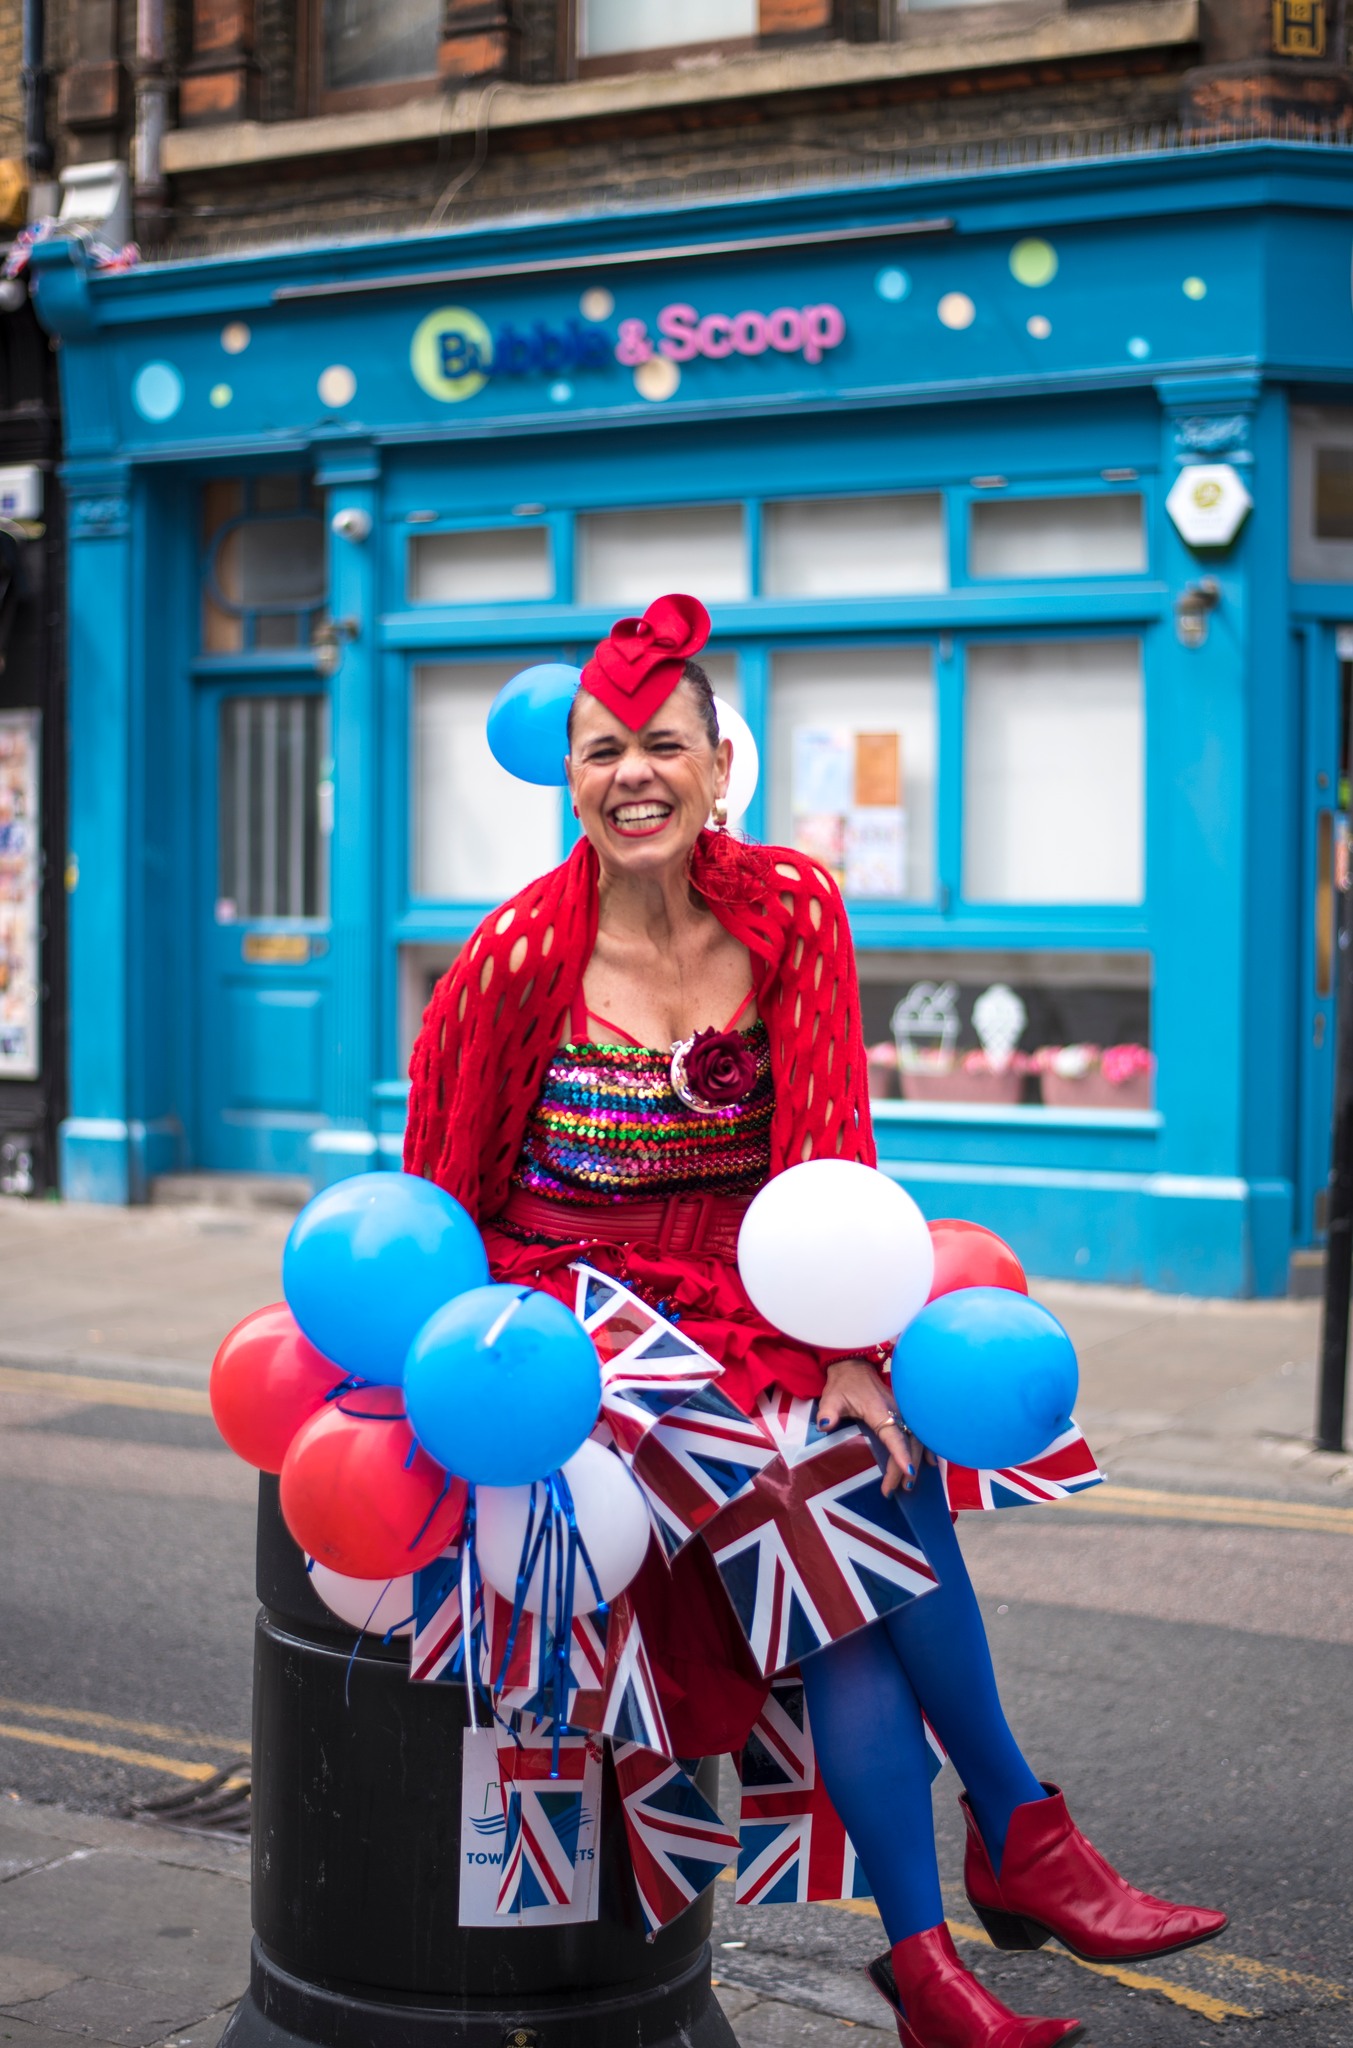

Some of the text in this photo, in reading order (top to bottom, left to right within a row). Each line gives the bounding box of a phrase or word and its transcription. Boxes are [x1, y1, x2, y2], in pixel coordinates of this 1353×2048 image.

[615, 318, 653, 366] &
[656, 303, 846, 364] Scoop
[467, 1853, 502, 1864] TOW
